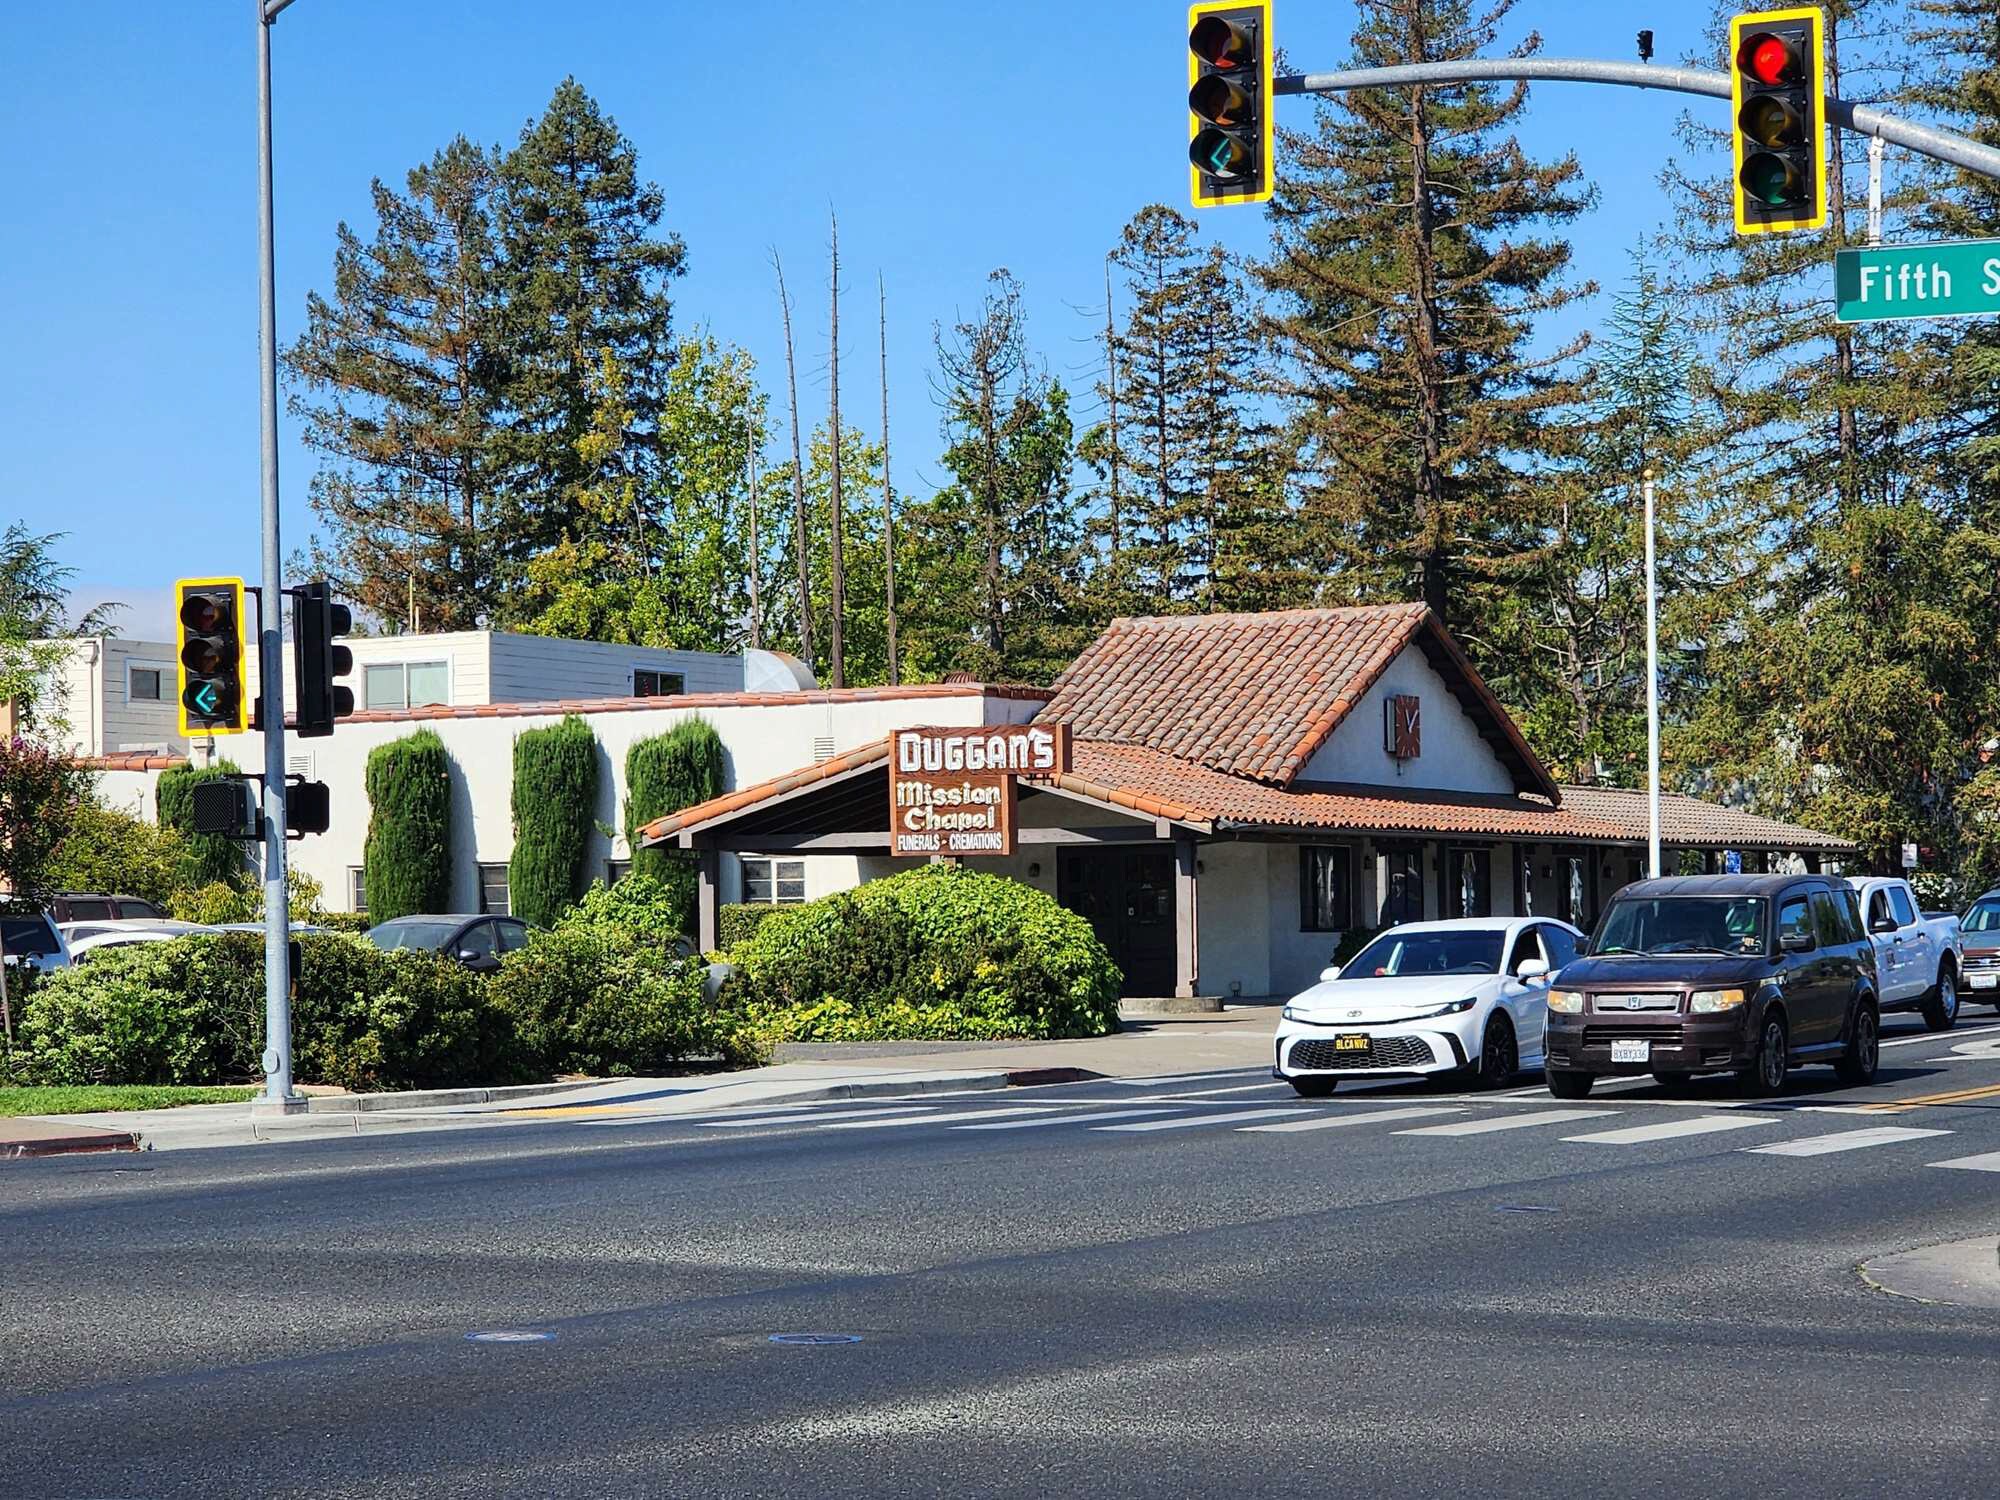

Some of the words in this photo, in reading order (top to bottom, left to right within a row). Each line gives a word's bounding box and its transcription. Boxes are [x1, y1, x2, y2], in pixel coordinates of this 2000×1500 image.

[1860, 262, 1952, 302] Fifth
[896, 781, 1001, 806] Mission
[904, 806, 995, 831] Chapel
[898, 834, 940, 850] FUNERALS
[949, 832, 1002, 849] CREMATIONS
